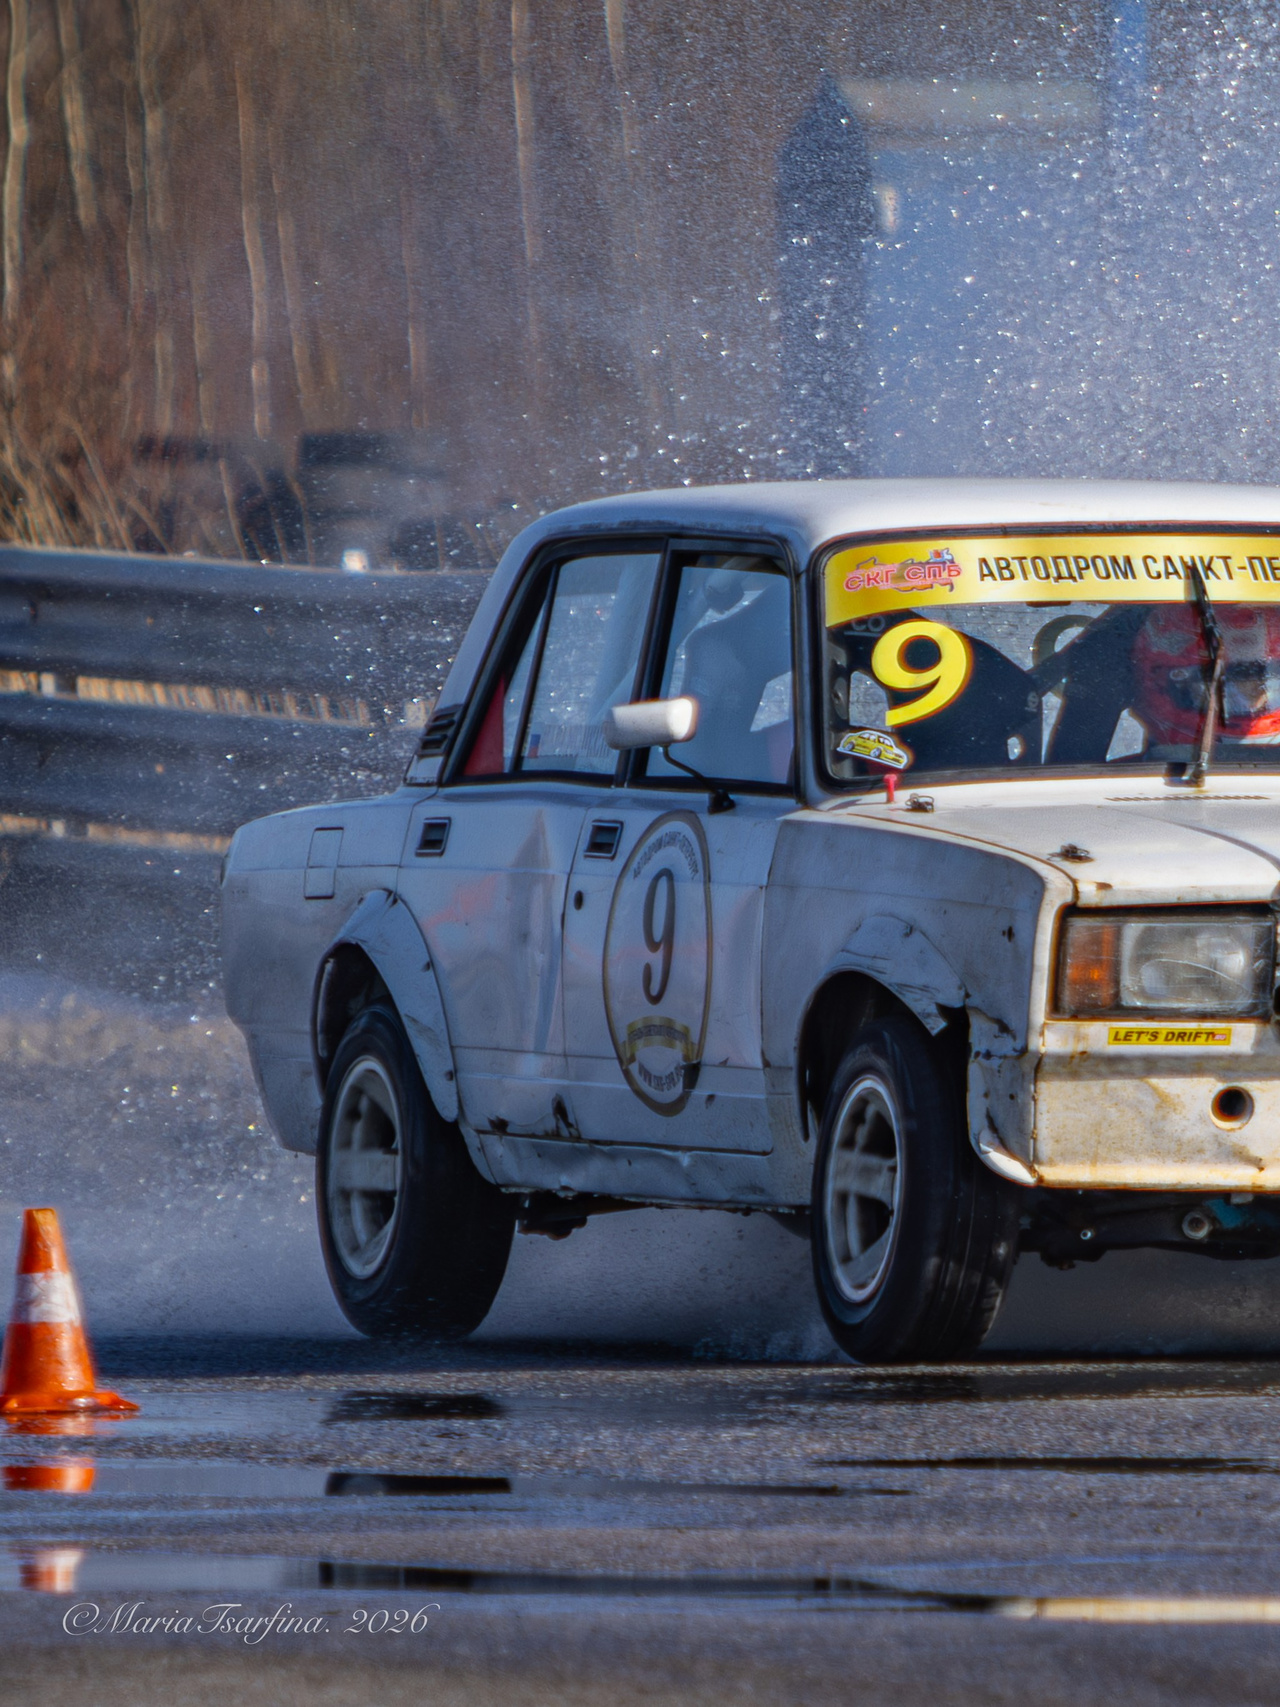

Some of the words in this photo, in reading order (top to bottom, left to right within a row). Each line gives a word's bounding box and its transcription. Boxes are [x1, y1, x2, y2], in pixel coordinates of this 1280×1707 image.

[844, 568, 897, 592] СКГ
[904, 563, 962, 581] СПБ
[978, 555, 1137, 583] АВТОДРОМ
[871, 620, 968, 727] 9
[643, 868, 676, 1006] 9
[1113, 1030, 1159, 1043] LET'S
